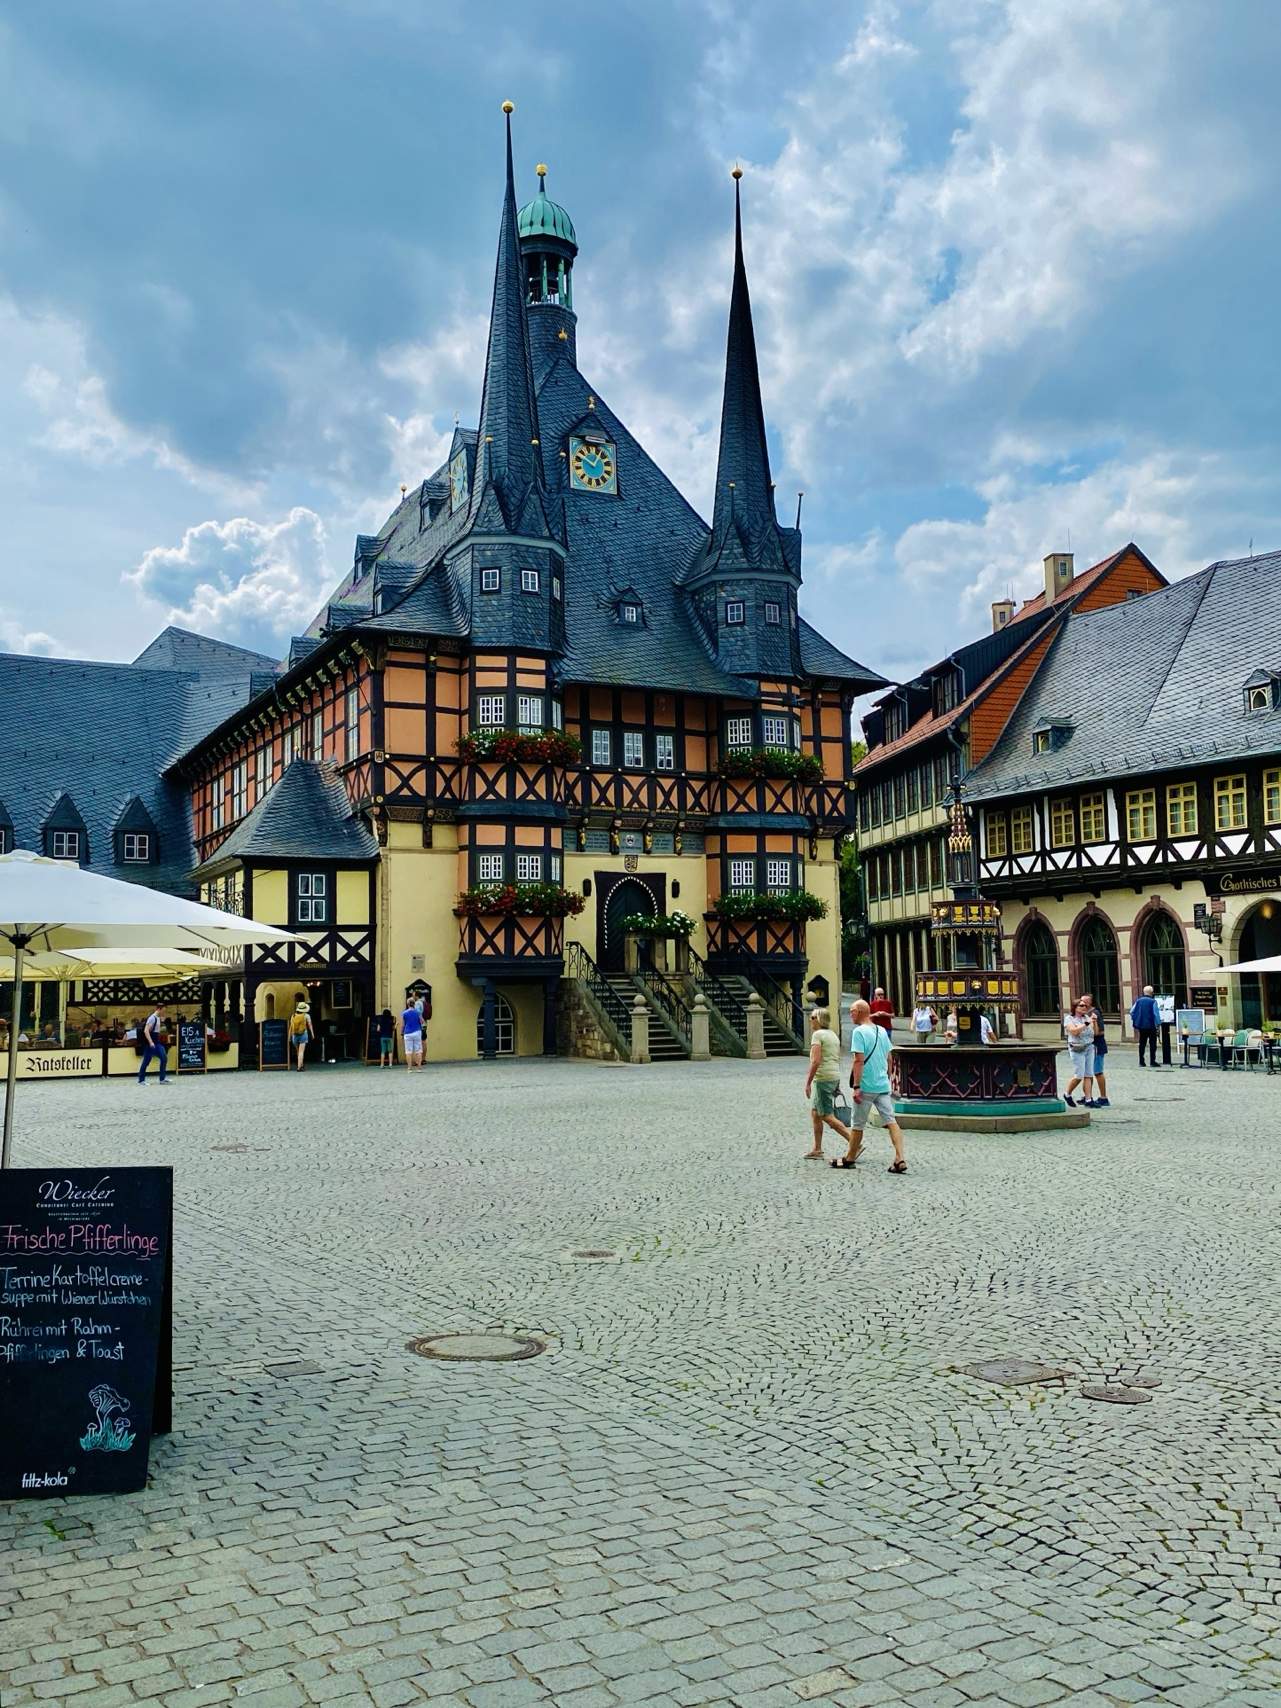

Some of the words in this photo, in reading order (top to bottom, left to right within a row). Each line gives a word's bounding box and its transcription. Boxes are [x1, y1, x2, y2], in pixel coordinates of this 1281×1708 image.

[1220, 873, 1278, 891] Gothisches
[181, 1026, 194, 1037] EIS
[26, 1056, 92, 1072] Ratskeller
[38, 1175, 116, 1200] Wiecker
[0, 1224, 67, 1250] Frische
[68, 1223, 160, 1257] Pfifferlinge
[0, 1266, 51, 1289] Terrine
[1, 1292, 34, 1308] suppe
[36, 1289, 58, 1304] mit
[61, 1288, 98, 1305] Wiener
[98, 1289, 152, 1306] Würstchen
[0, 1316, 43, 1337] Rührei
[46, 1318, 68, 1337] mit
[76, 1338, 87, 1358] &
[88, 1339, 125, 1360] Toast
[22, 1471, 68, 1488] fritz-kola
